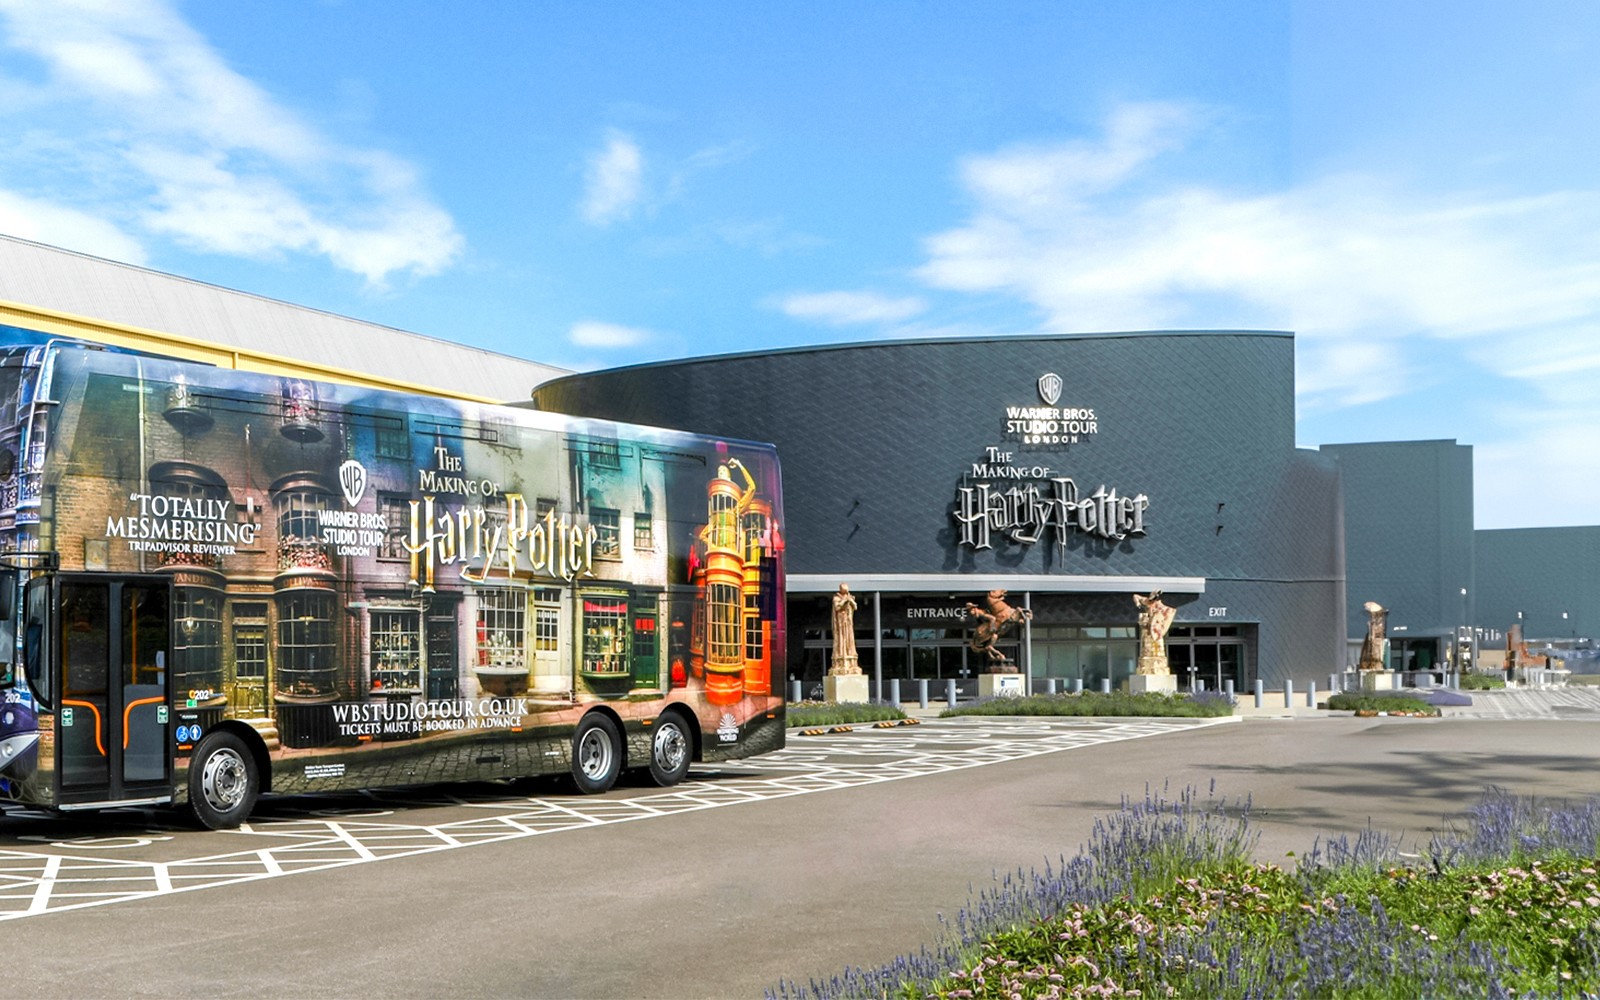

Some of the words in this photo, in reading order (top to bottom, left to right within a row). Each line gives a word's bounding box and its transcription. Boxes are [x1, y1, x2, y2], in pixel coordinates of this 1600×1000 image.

[1006, 406, 1060, 420] WARNER
[1063, 407, 1098, 421] BROS.
[1006, 420, 1058, 434] STUDIO
[1061, 420, 1098, 434] TOUR
[1024, 434, 1078, 444] LONDON
[317, 509, 359, 528] WARNER
[953, 483, 1055, 550] Harry
[1051, 478, 1150, 568] Potter
[322, 528, 357, 546] STUDIO
[358, 529, 384, 547] TOUR
[401, 496, 502, 593] Harry
[505, 493, 598, 584] Potter
[128, 540, 191, 554] TRIPADVISOR
[192, 544, 236, 556] REVIEWER
[336, 545, 370, 557] LONDON
[907, 608, 967, 618] ENTRANCE
[1208, 606, 1227, 617] EXIT
[332, 698, 528, 723] WBSTUDIOTOUR.CO.UK
[339, 723, 381, 736] TICKETS
[383, 721, 411, 734] MUST
[412, 720, 423, 732] BE
[425, 718, 465, 731] BOOKED
[467, 718, 478, 729] IN
[480, 716, 522, 728] ADVANCE
